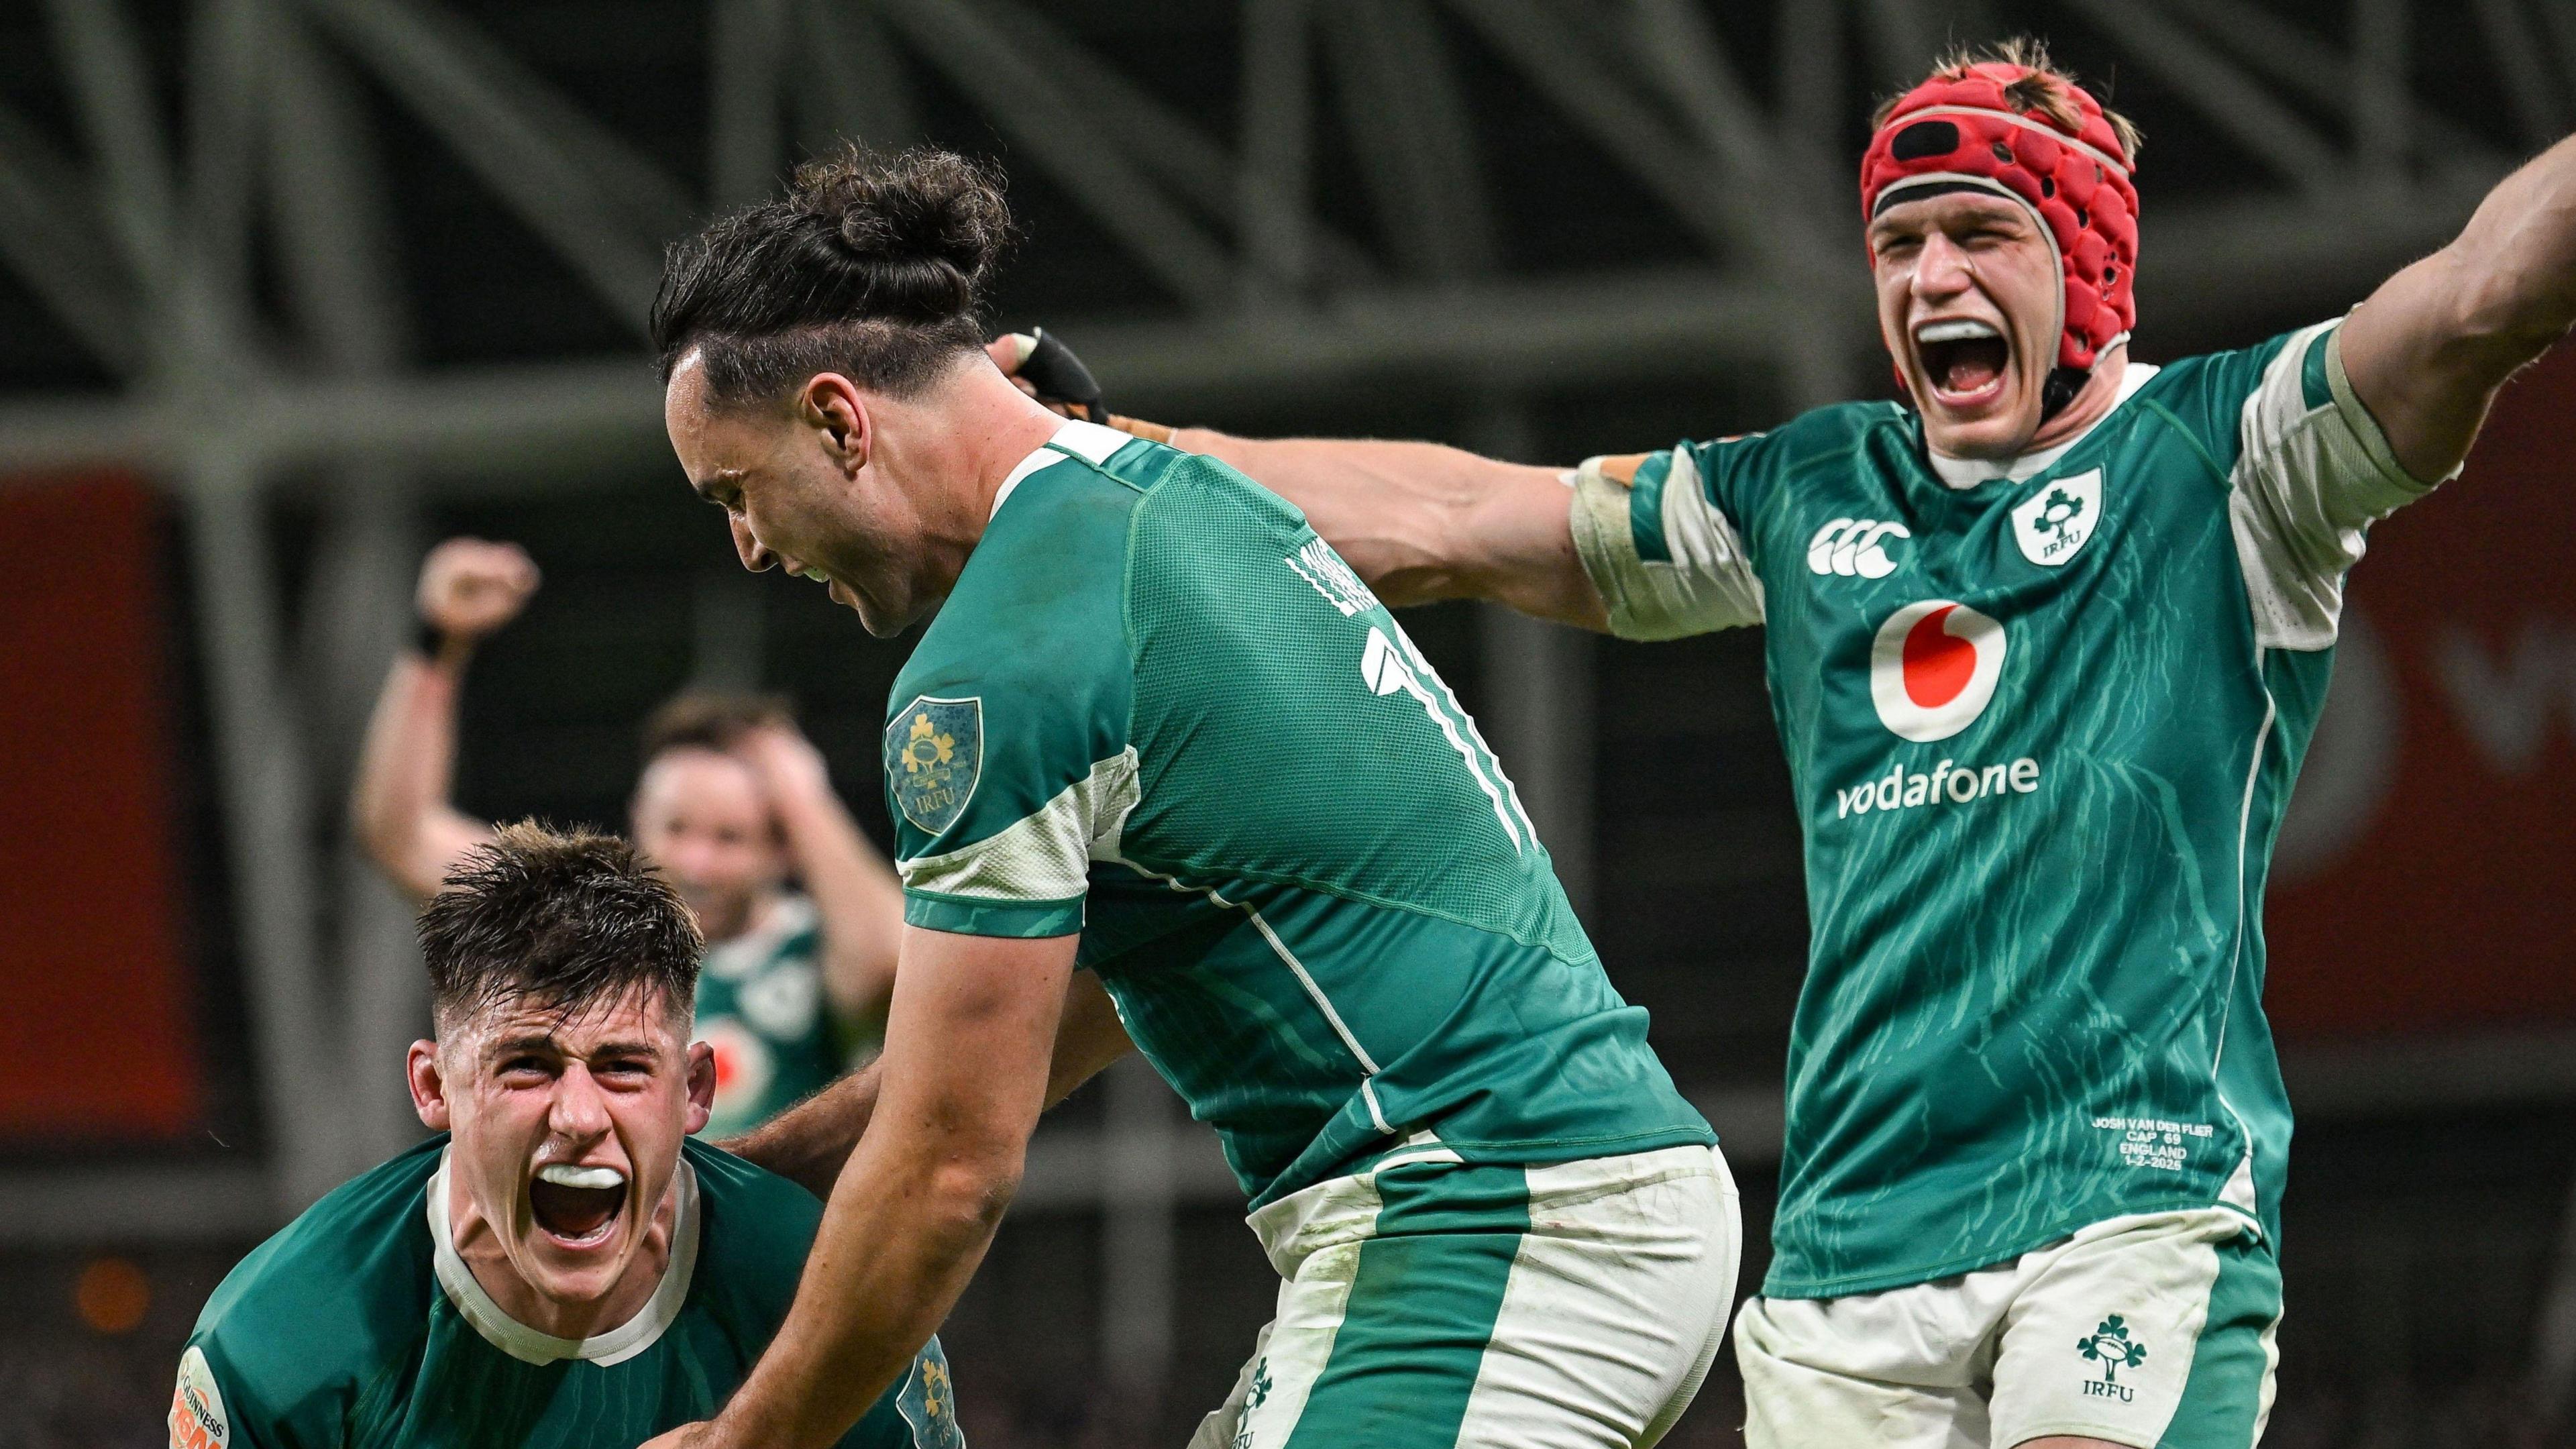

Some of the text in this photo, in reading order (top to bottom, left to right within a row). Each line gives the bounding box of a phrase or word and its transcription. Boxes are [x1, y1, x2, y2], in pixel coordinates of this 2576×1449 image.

[2043, 531, 2081, 558] IRFU
[916, 787, 955, 814] IRFU
[1837, 757, 2040, 819] vodafone
[2092, 1117, 2213, 1138] JOSH VAN DER FLIER
[2126, 1131, 2182, 1145] CAP 69
[2120, 1143, 2186, 1159] ENGLAND
[2083, 1380, 2134, 1403] IRFU
[182, 1375, 224, 1438] GUINNESS
